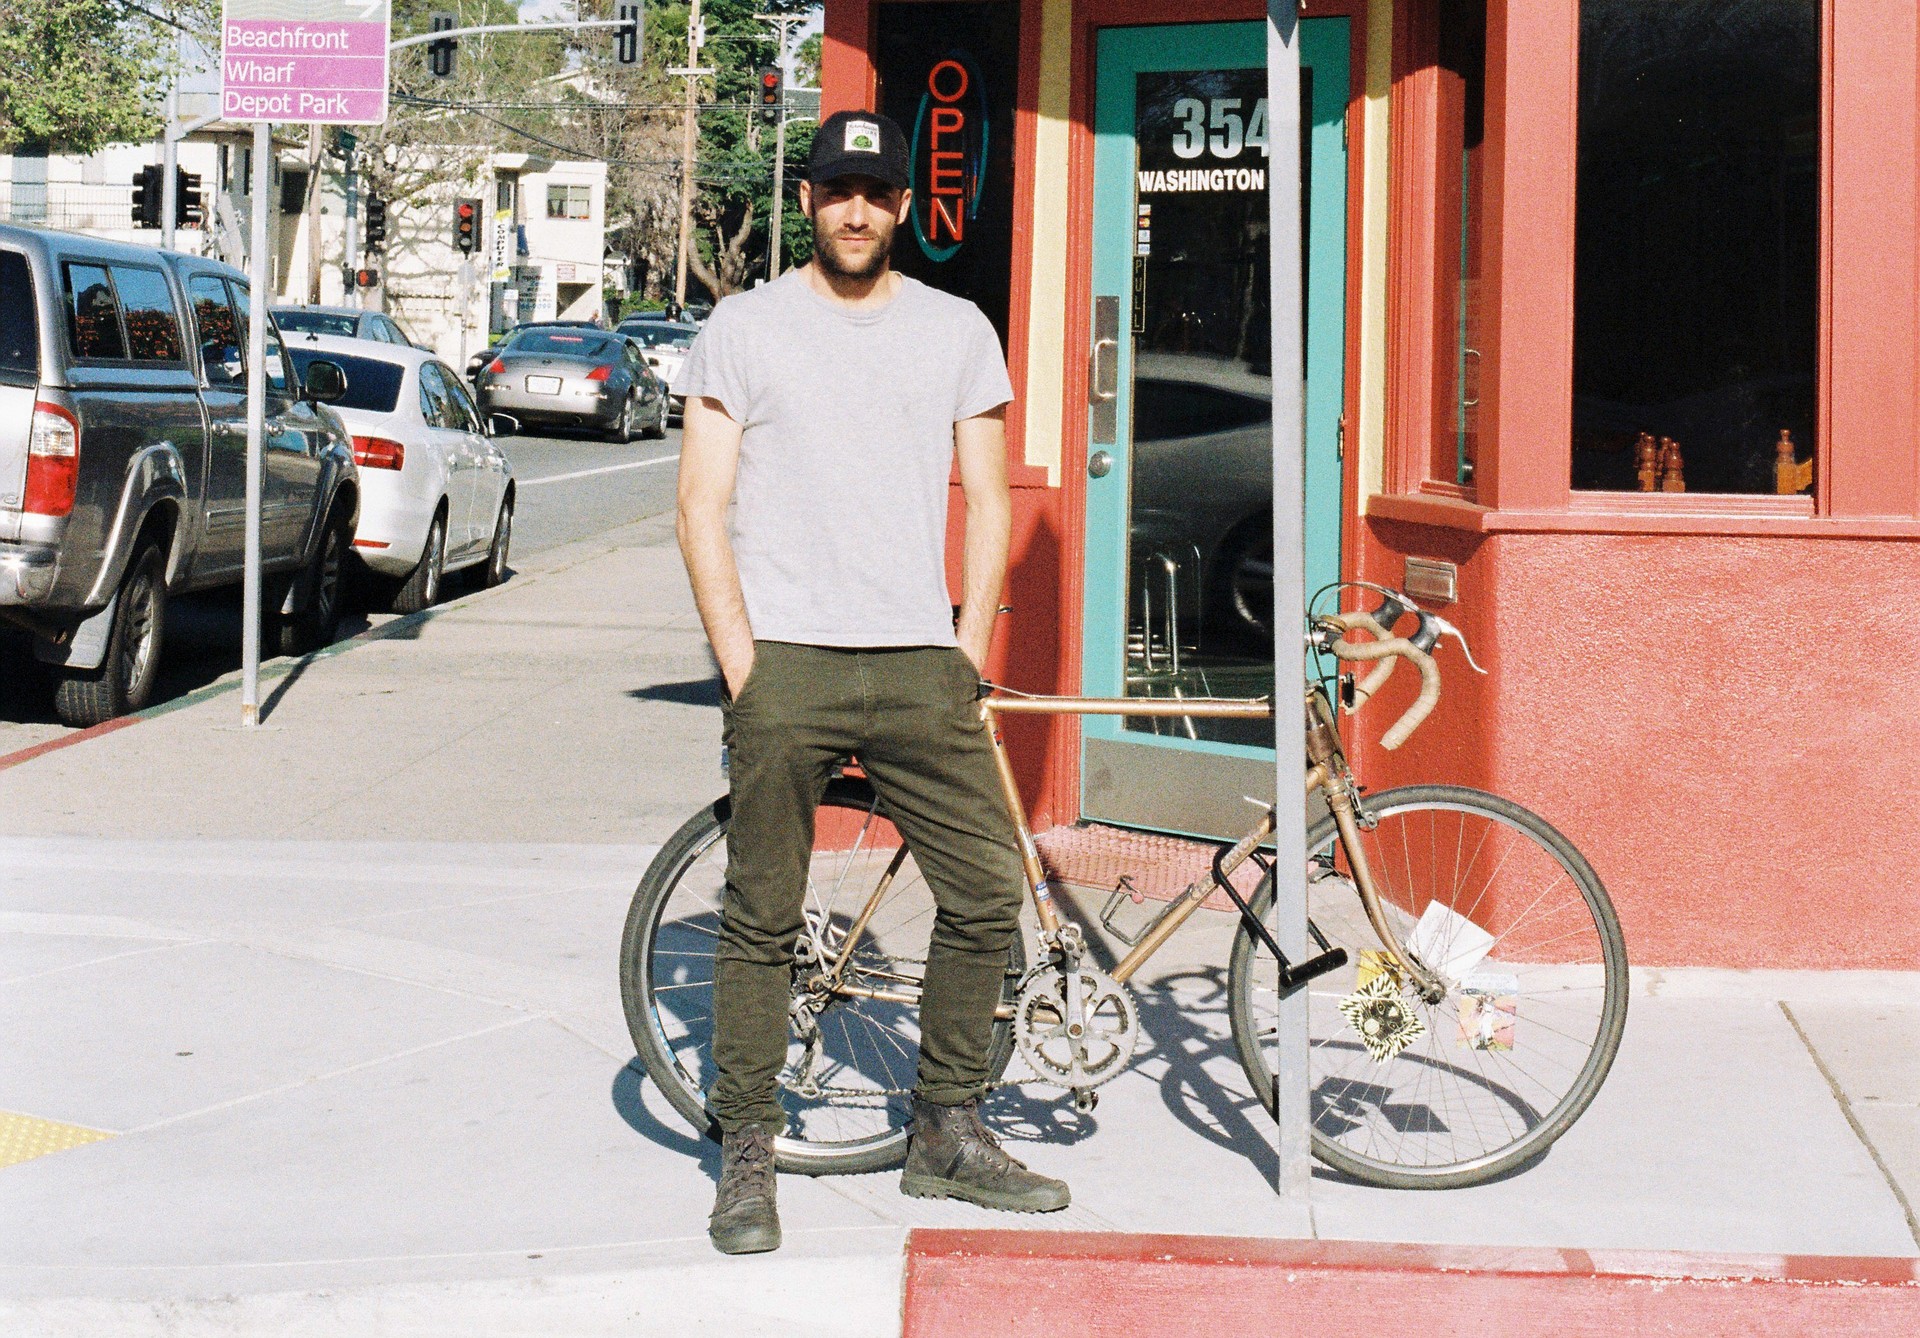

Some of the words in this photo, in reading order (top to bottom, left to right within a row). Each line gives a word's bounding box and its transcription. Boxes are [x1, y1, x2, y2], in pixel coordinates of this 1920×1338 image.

[227, 26, 349, 49] Beachfront
[226, 61, 295, 83] Wharf
[225, 91, 292, 117] Depot
[299, 93, 349, 115] Park
[1172, 97, 1270, 159] 354
[929, 60, 968, 241] OPEN
[1138, 168, 1265, 192] WASHINGTON
[496, 223, 506, 267] COMPUTER
[1134, 259, 1143, 328] PULL
